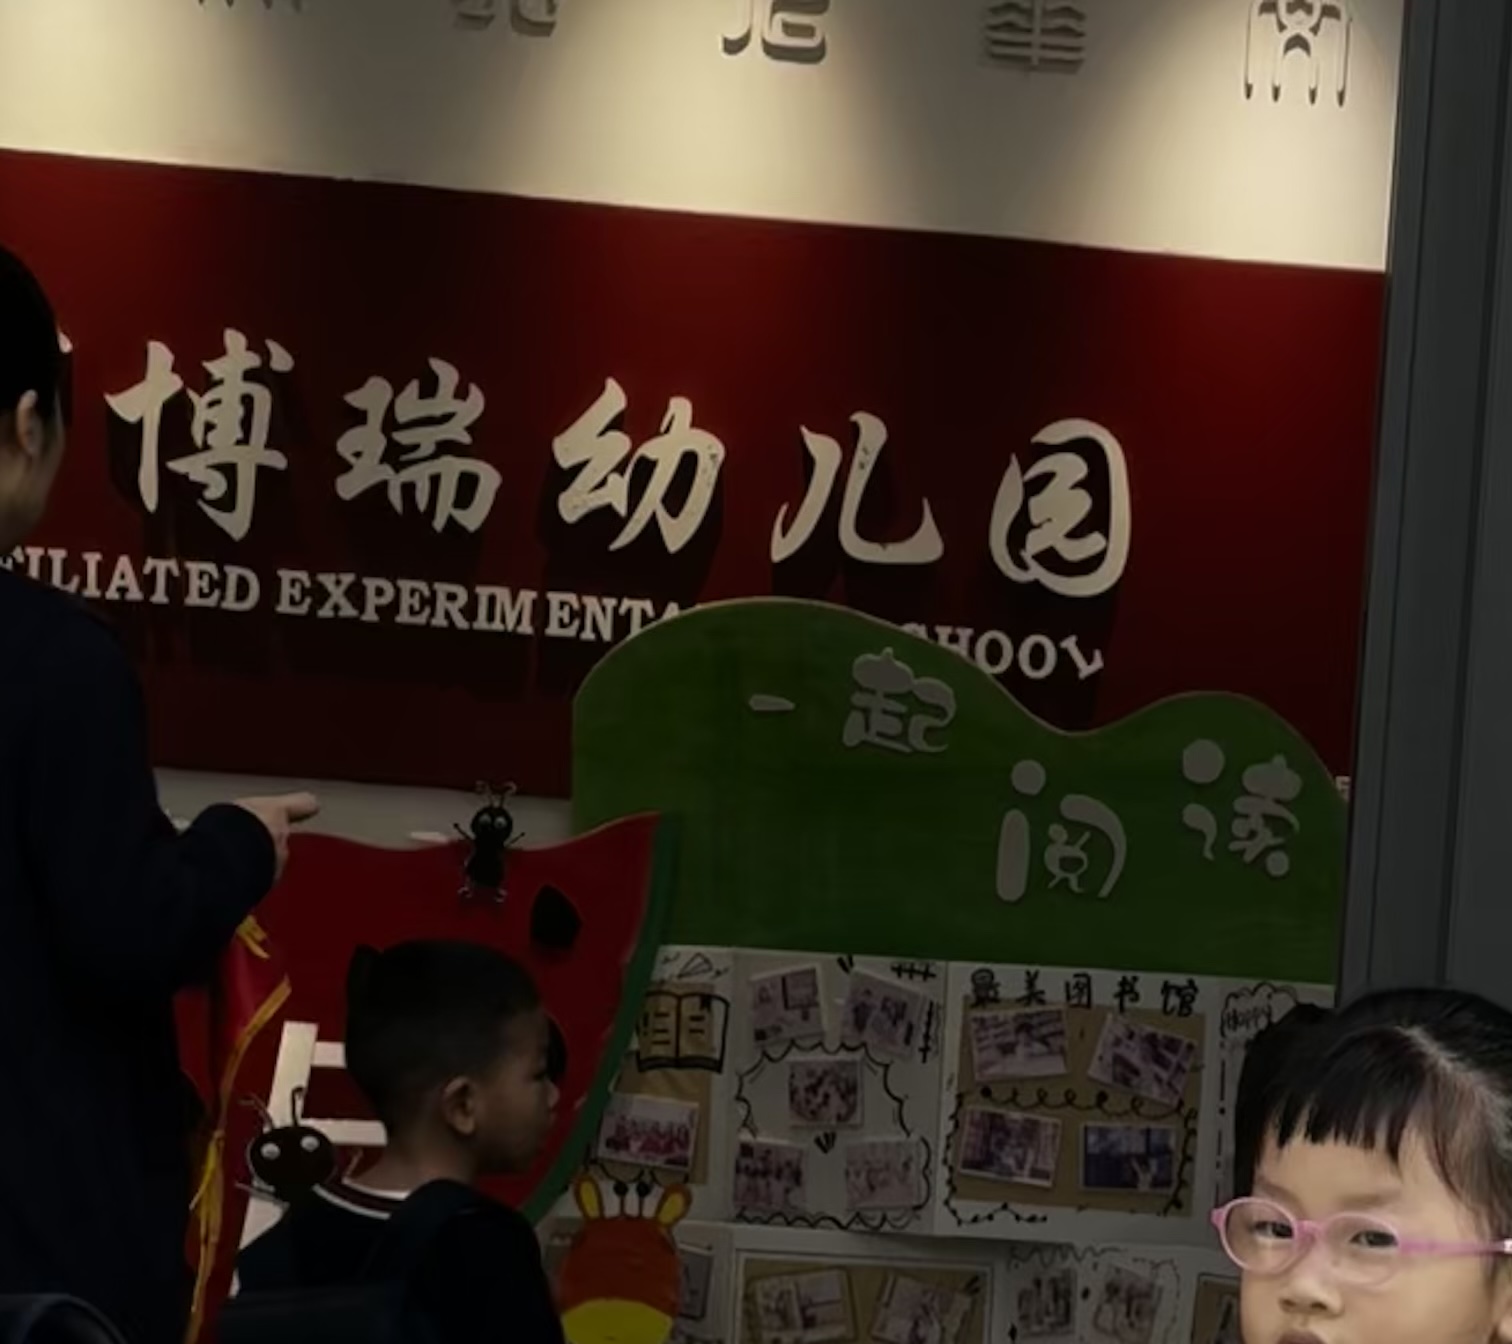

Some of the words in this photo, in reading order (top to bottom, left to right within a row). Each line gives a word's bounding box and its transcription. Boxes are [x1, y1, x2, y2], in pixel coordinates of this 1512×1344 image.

[104, 328, 1131, 597] 博瑞幼儿园
[970, 967, 1199, 1017] 最美图书馆
